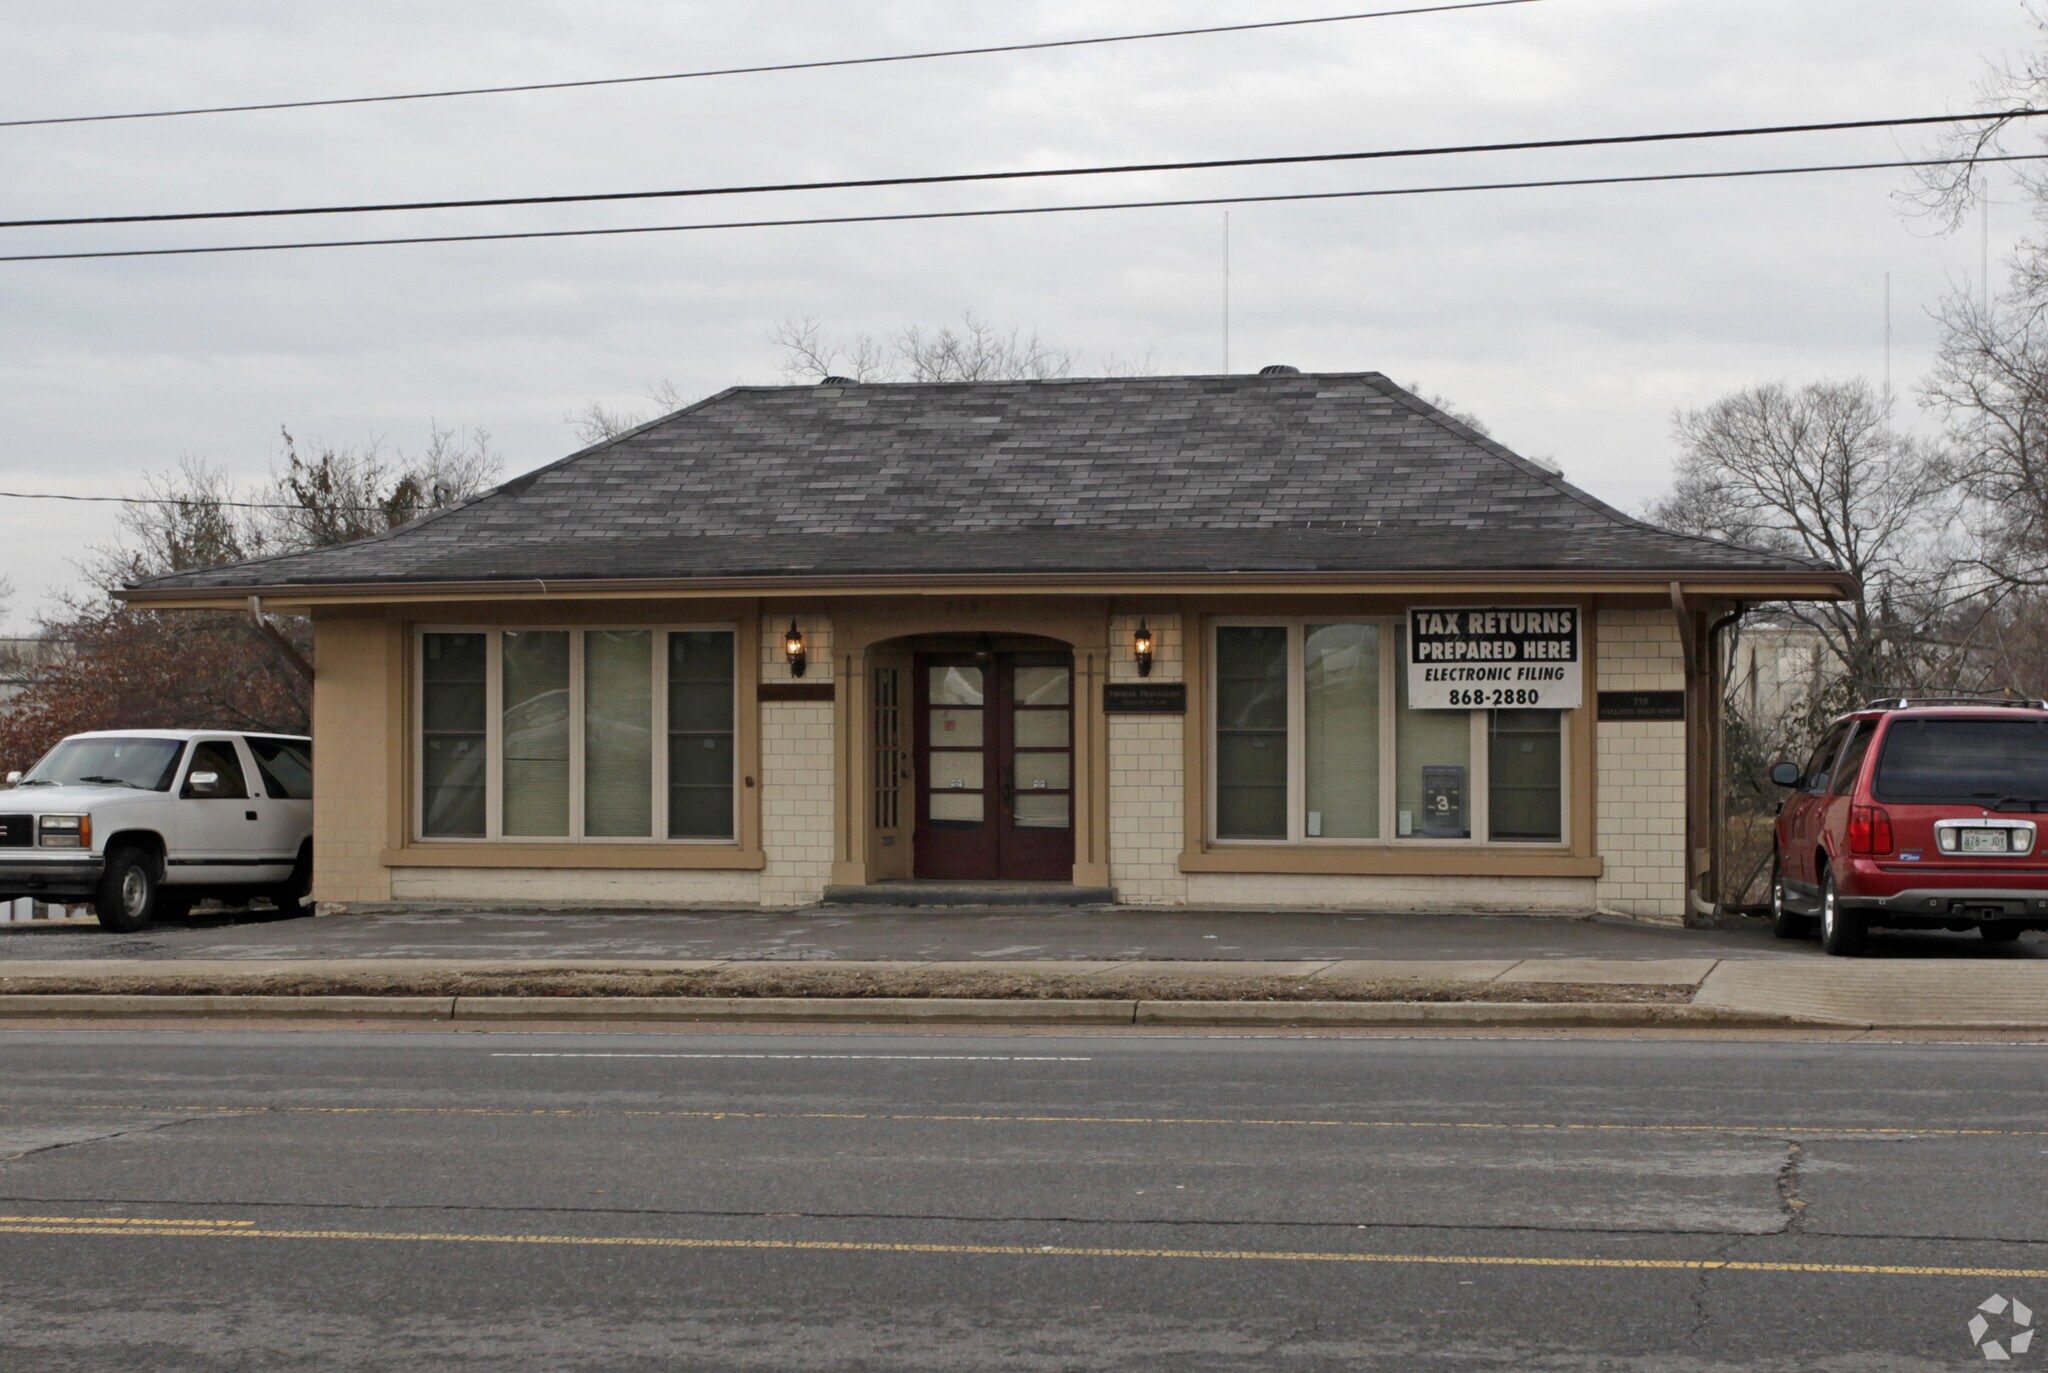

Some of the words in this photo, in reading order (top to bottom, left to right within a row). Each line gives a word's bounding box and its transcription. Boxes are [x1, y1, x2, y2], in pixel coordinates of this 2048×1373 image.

[1416, 613, 1460, 635] TAX
[1468, 612, 1572, 635] RETURNS
[1418, 641, 1517, 660] PREPARED
[1523, 641, 1571, 659] HERE
[1424, 667, 1512, 682] ELECTRONIC
[1517, 667, 1565, 681] FILING
[1449, 688, 1539, 706] 868-2880
[1436, 795, 1449, 811] 3
